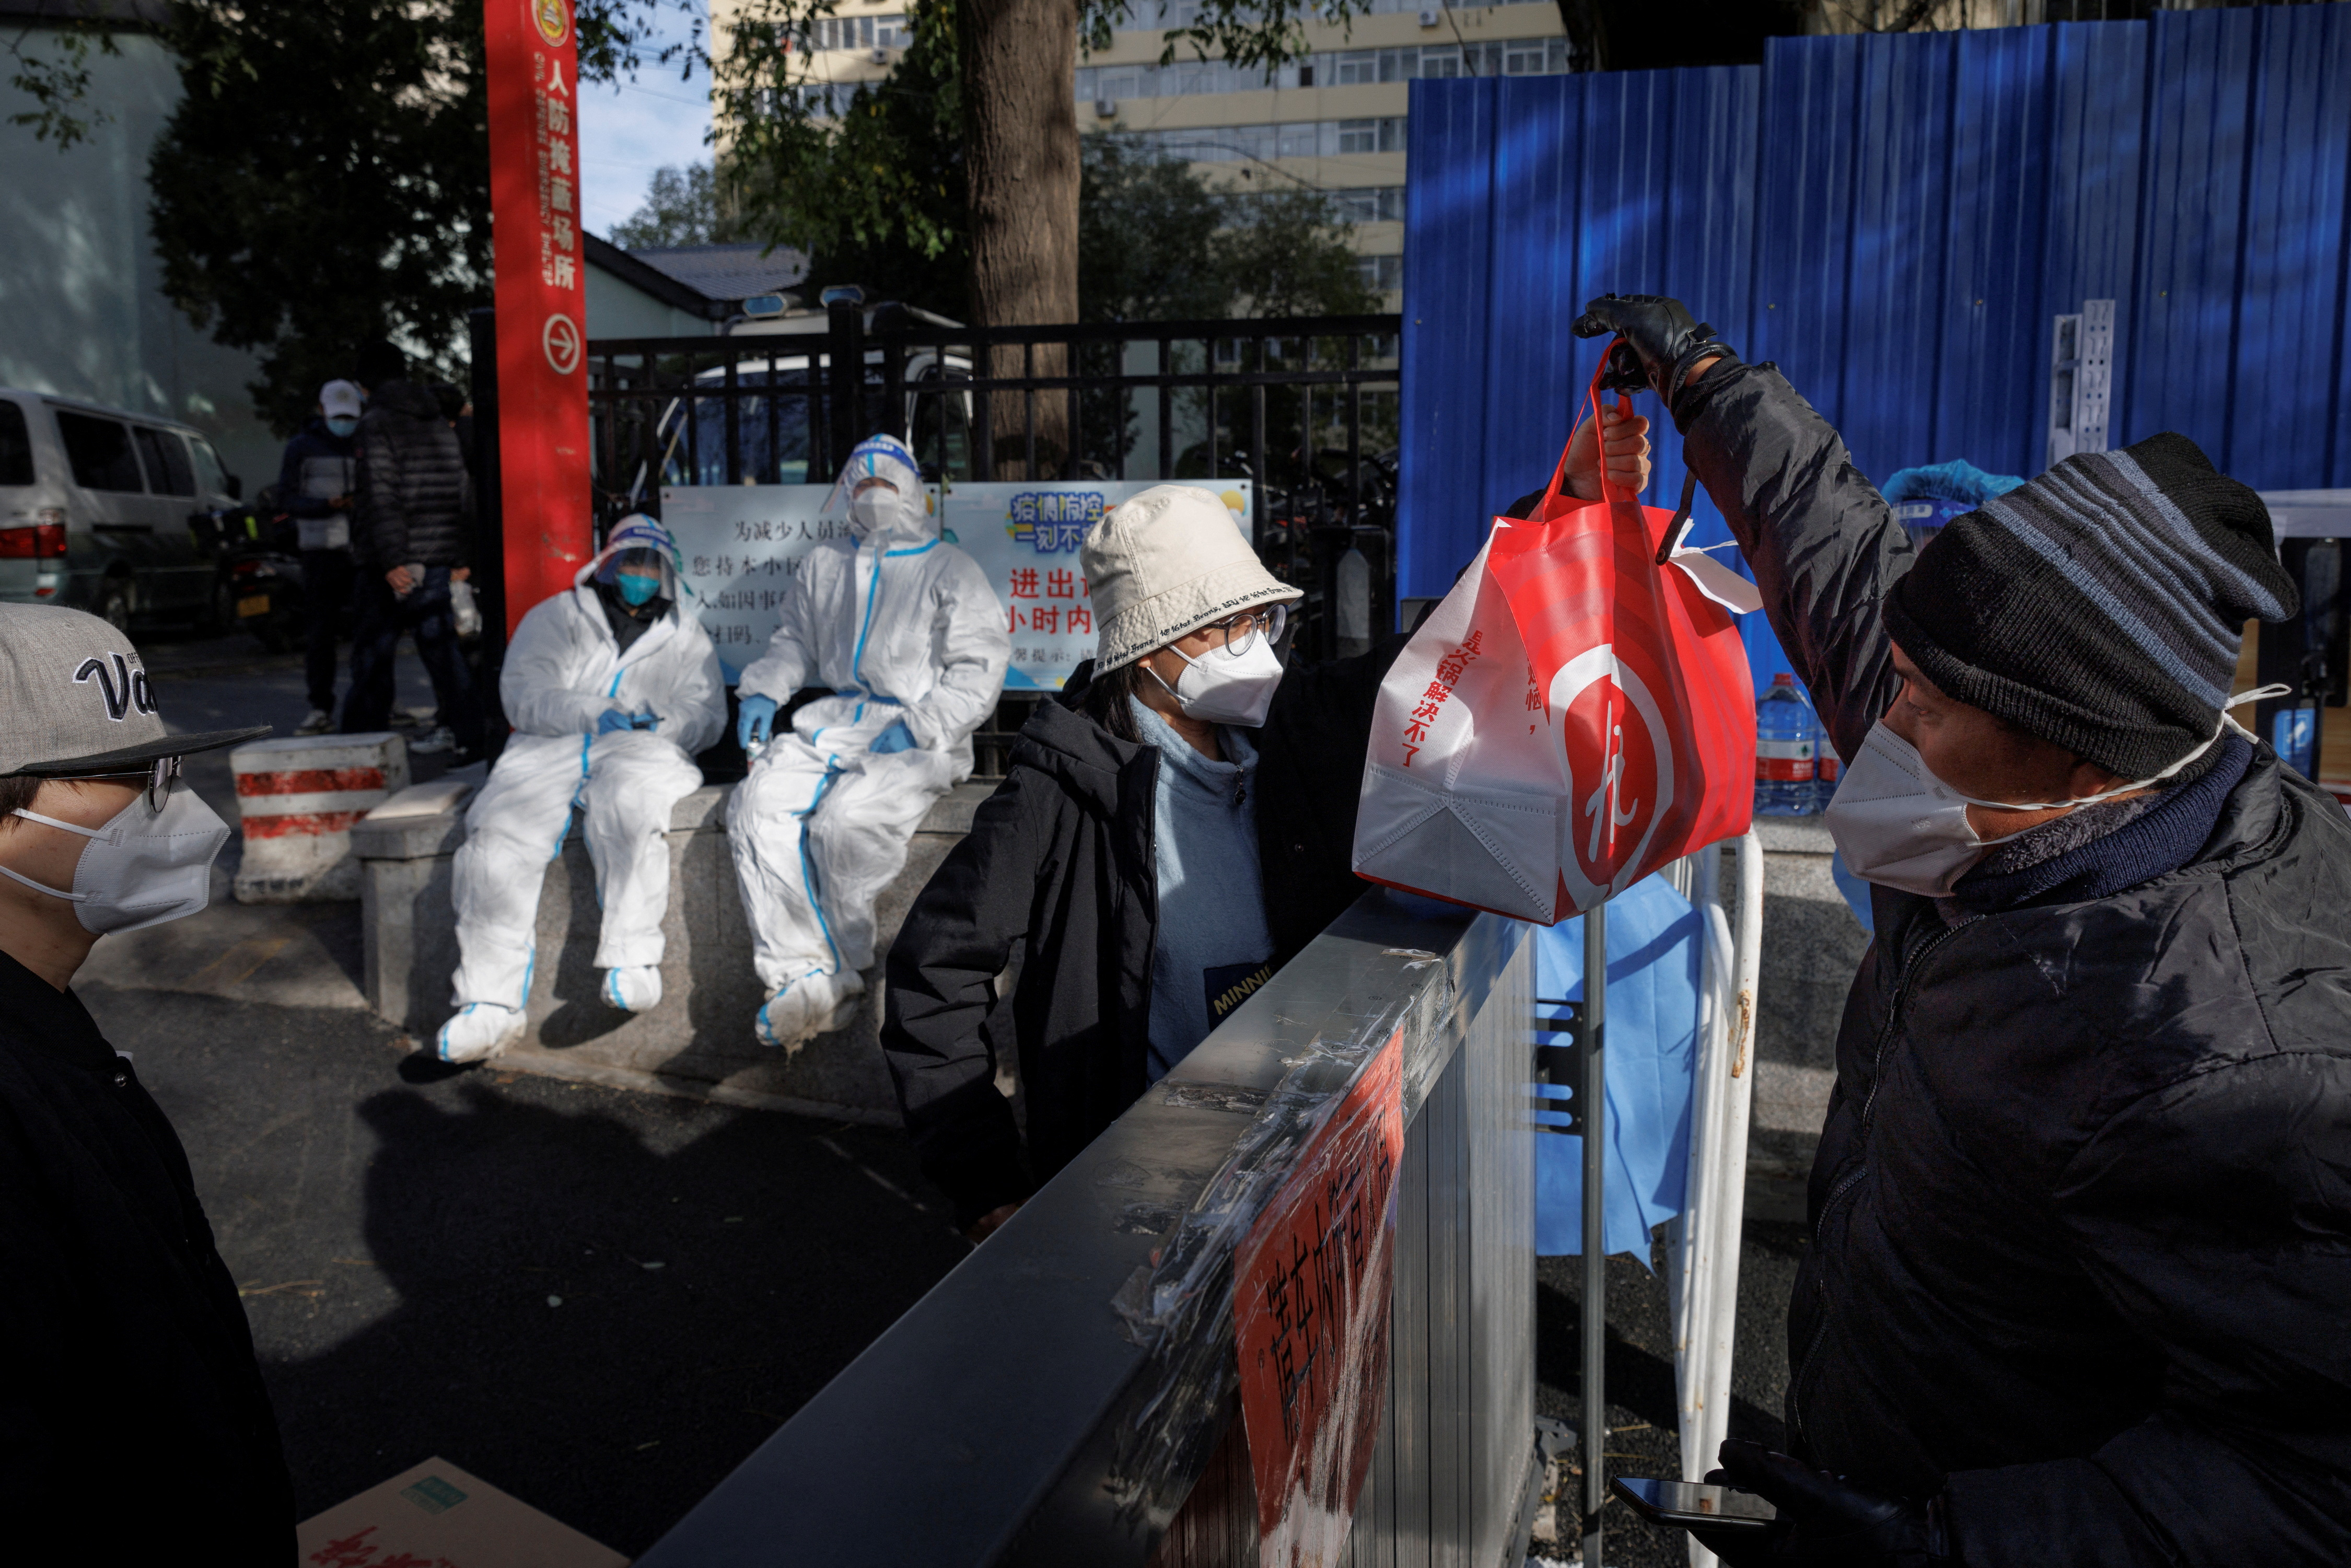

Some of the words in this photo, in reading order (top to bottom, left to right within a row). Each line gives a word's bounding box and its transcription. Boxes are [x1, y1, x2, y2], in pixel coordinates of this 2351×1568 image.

[534, 51, 545, 82] CIVIL
[536, 88, 548, 145] DEFENSE
[537, 149, 551, 227] EMERGENCY
[547, 59, 576, 291] 人防掩蔽场所
[540, 231, 554, 286] SHELTER
[1012, 493, 1102, 521] 疫情防控
[1016, 524, 1090, 551] 一刻不
[1009, 568, 1090, 600] 进出
[1007, 605, 1091, 634] 小时内
[1171, 620, 1190, 633] 161st
[72, 651, 159, 722] Va
[1402, 630, 1483, 768] 是火锅解决不了
